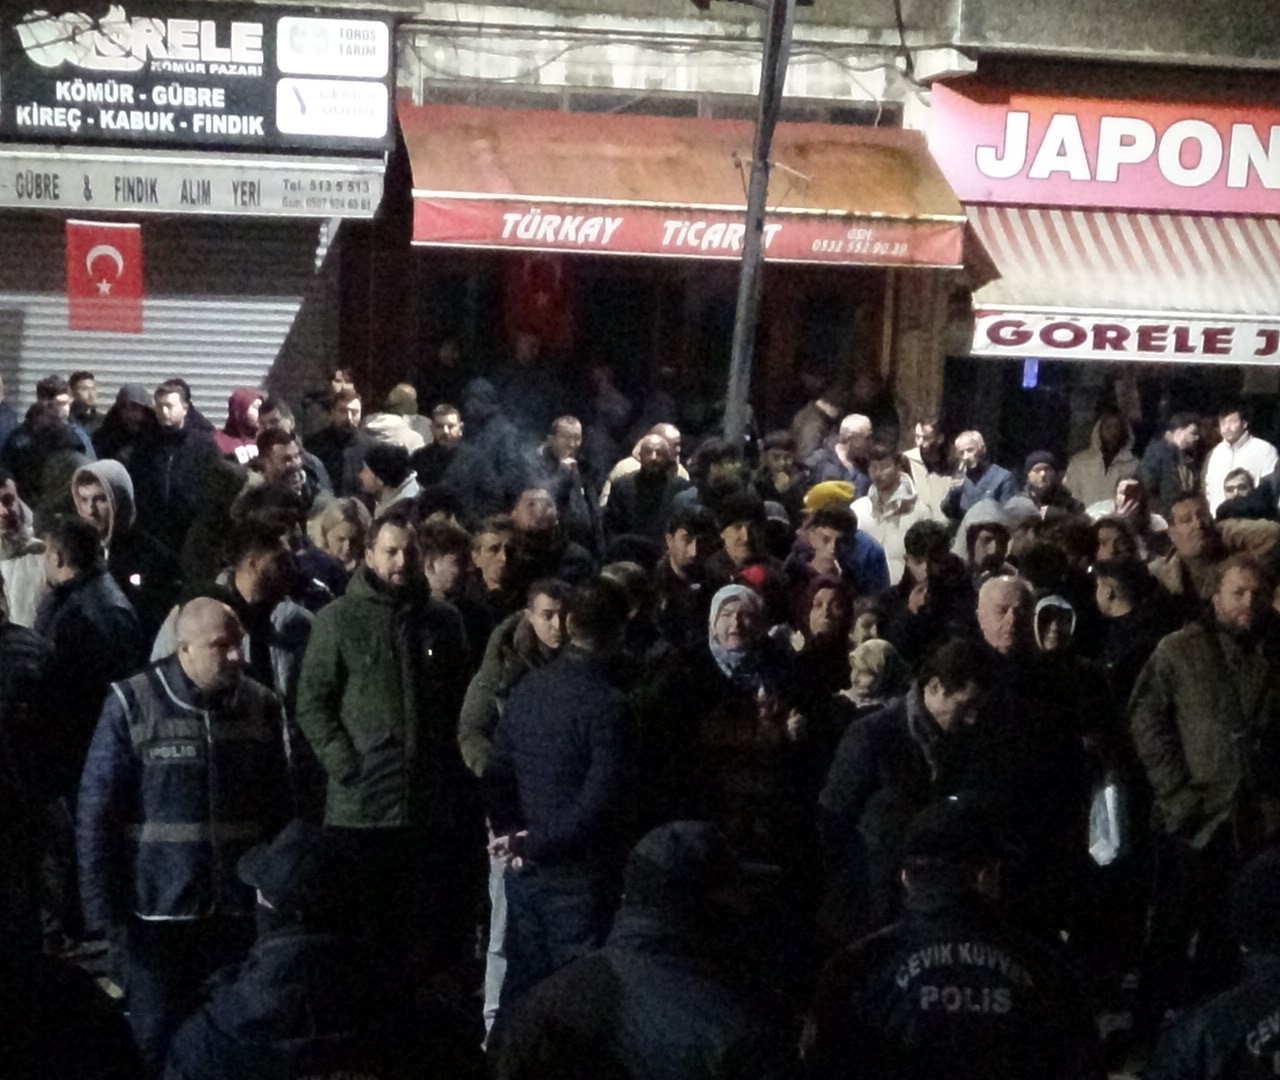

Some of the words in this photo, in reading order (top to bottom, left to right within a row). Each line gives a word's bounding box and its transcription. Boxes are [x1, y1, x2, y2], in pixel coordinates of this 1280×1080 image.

[339, 28, 376, 41] TOROS
[209, 62, 263, 77] PAZARI
[55, 79, 134, 104] KÖMÜR
[152, 83, 225, 108] GÜBRE
[16, 102, 79, 131] KİREÇ
[100, 109, 175, 132] KABUK
[193, 114, 264, 135] FINDIK
[114, 176, 159, 204] FINDIK
[180, 179, 212, 205] ALIM
[502, 208, 624, 245] TÜRKAY
[661, 219, 783, 251] TİCART
[985, 317, 1235, 355] GÖRELE
